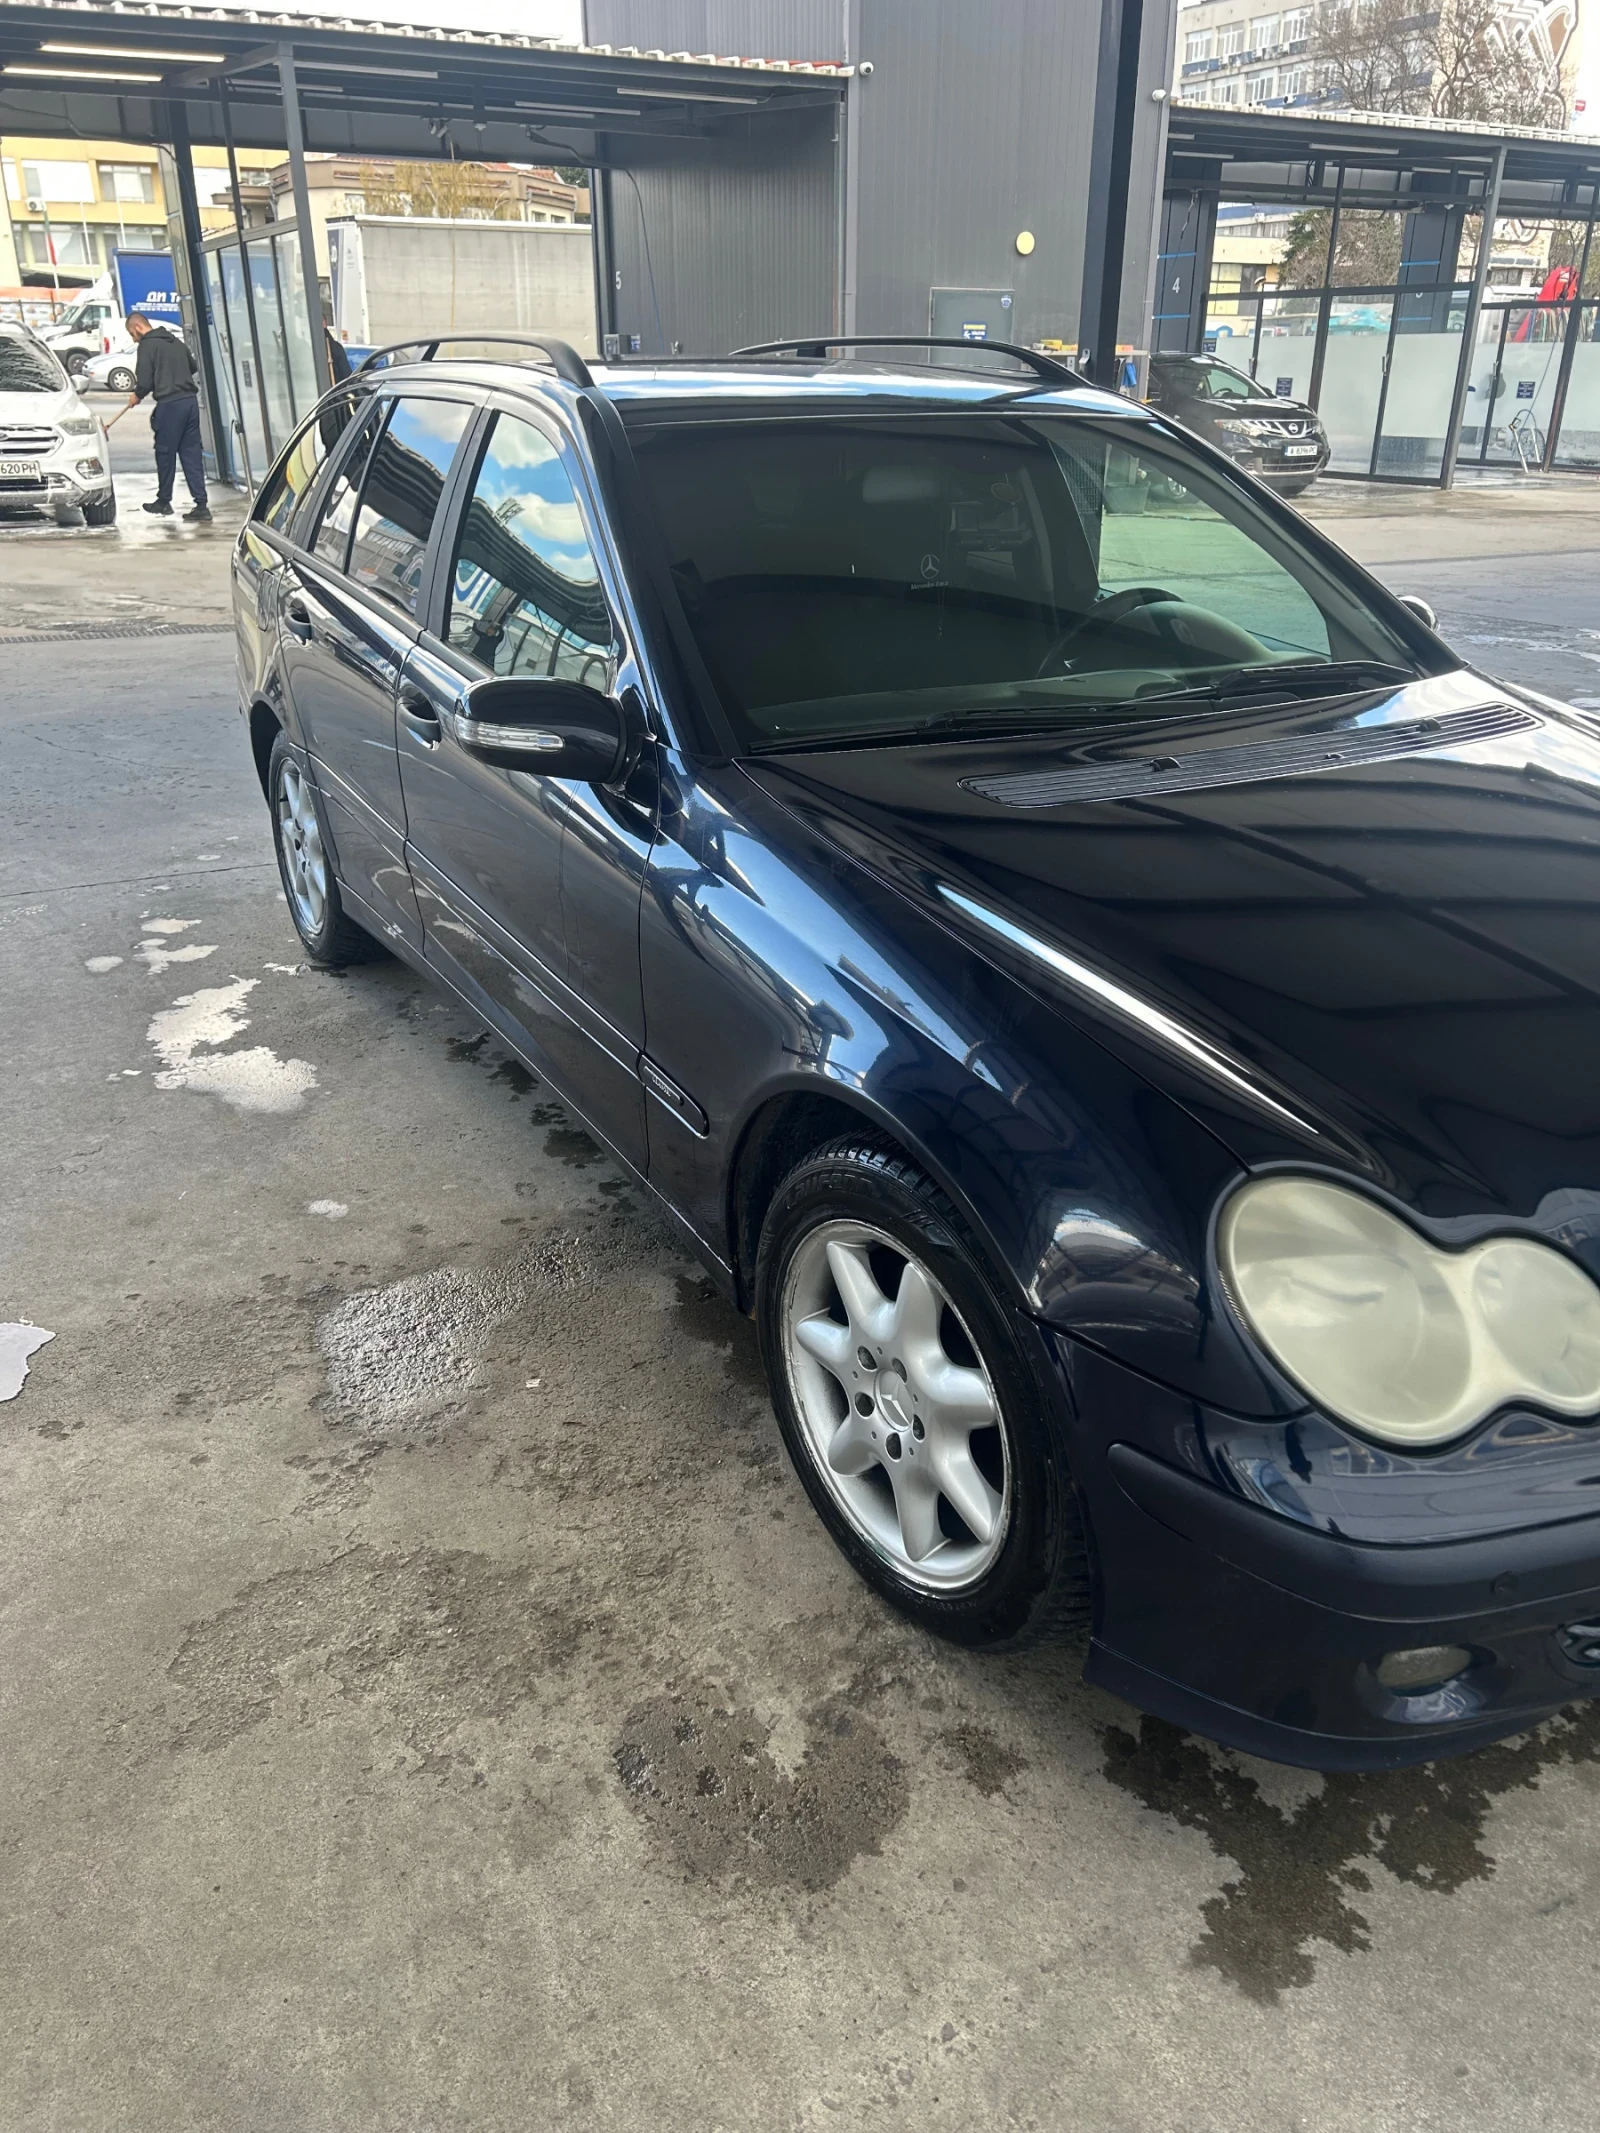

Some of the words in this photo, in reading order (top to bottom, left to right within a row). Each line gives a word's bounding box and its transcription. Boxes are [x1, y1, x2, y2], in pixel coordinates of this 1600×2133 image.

[615, 270, 622, 290] 5
[1172, 277, 1180, 294] 4
[21, 463, 36, 474] PH
